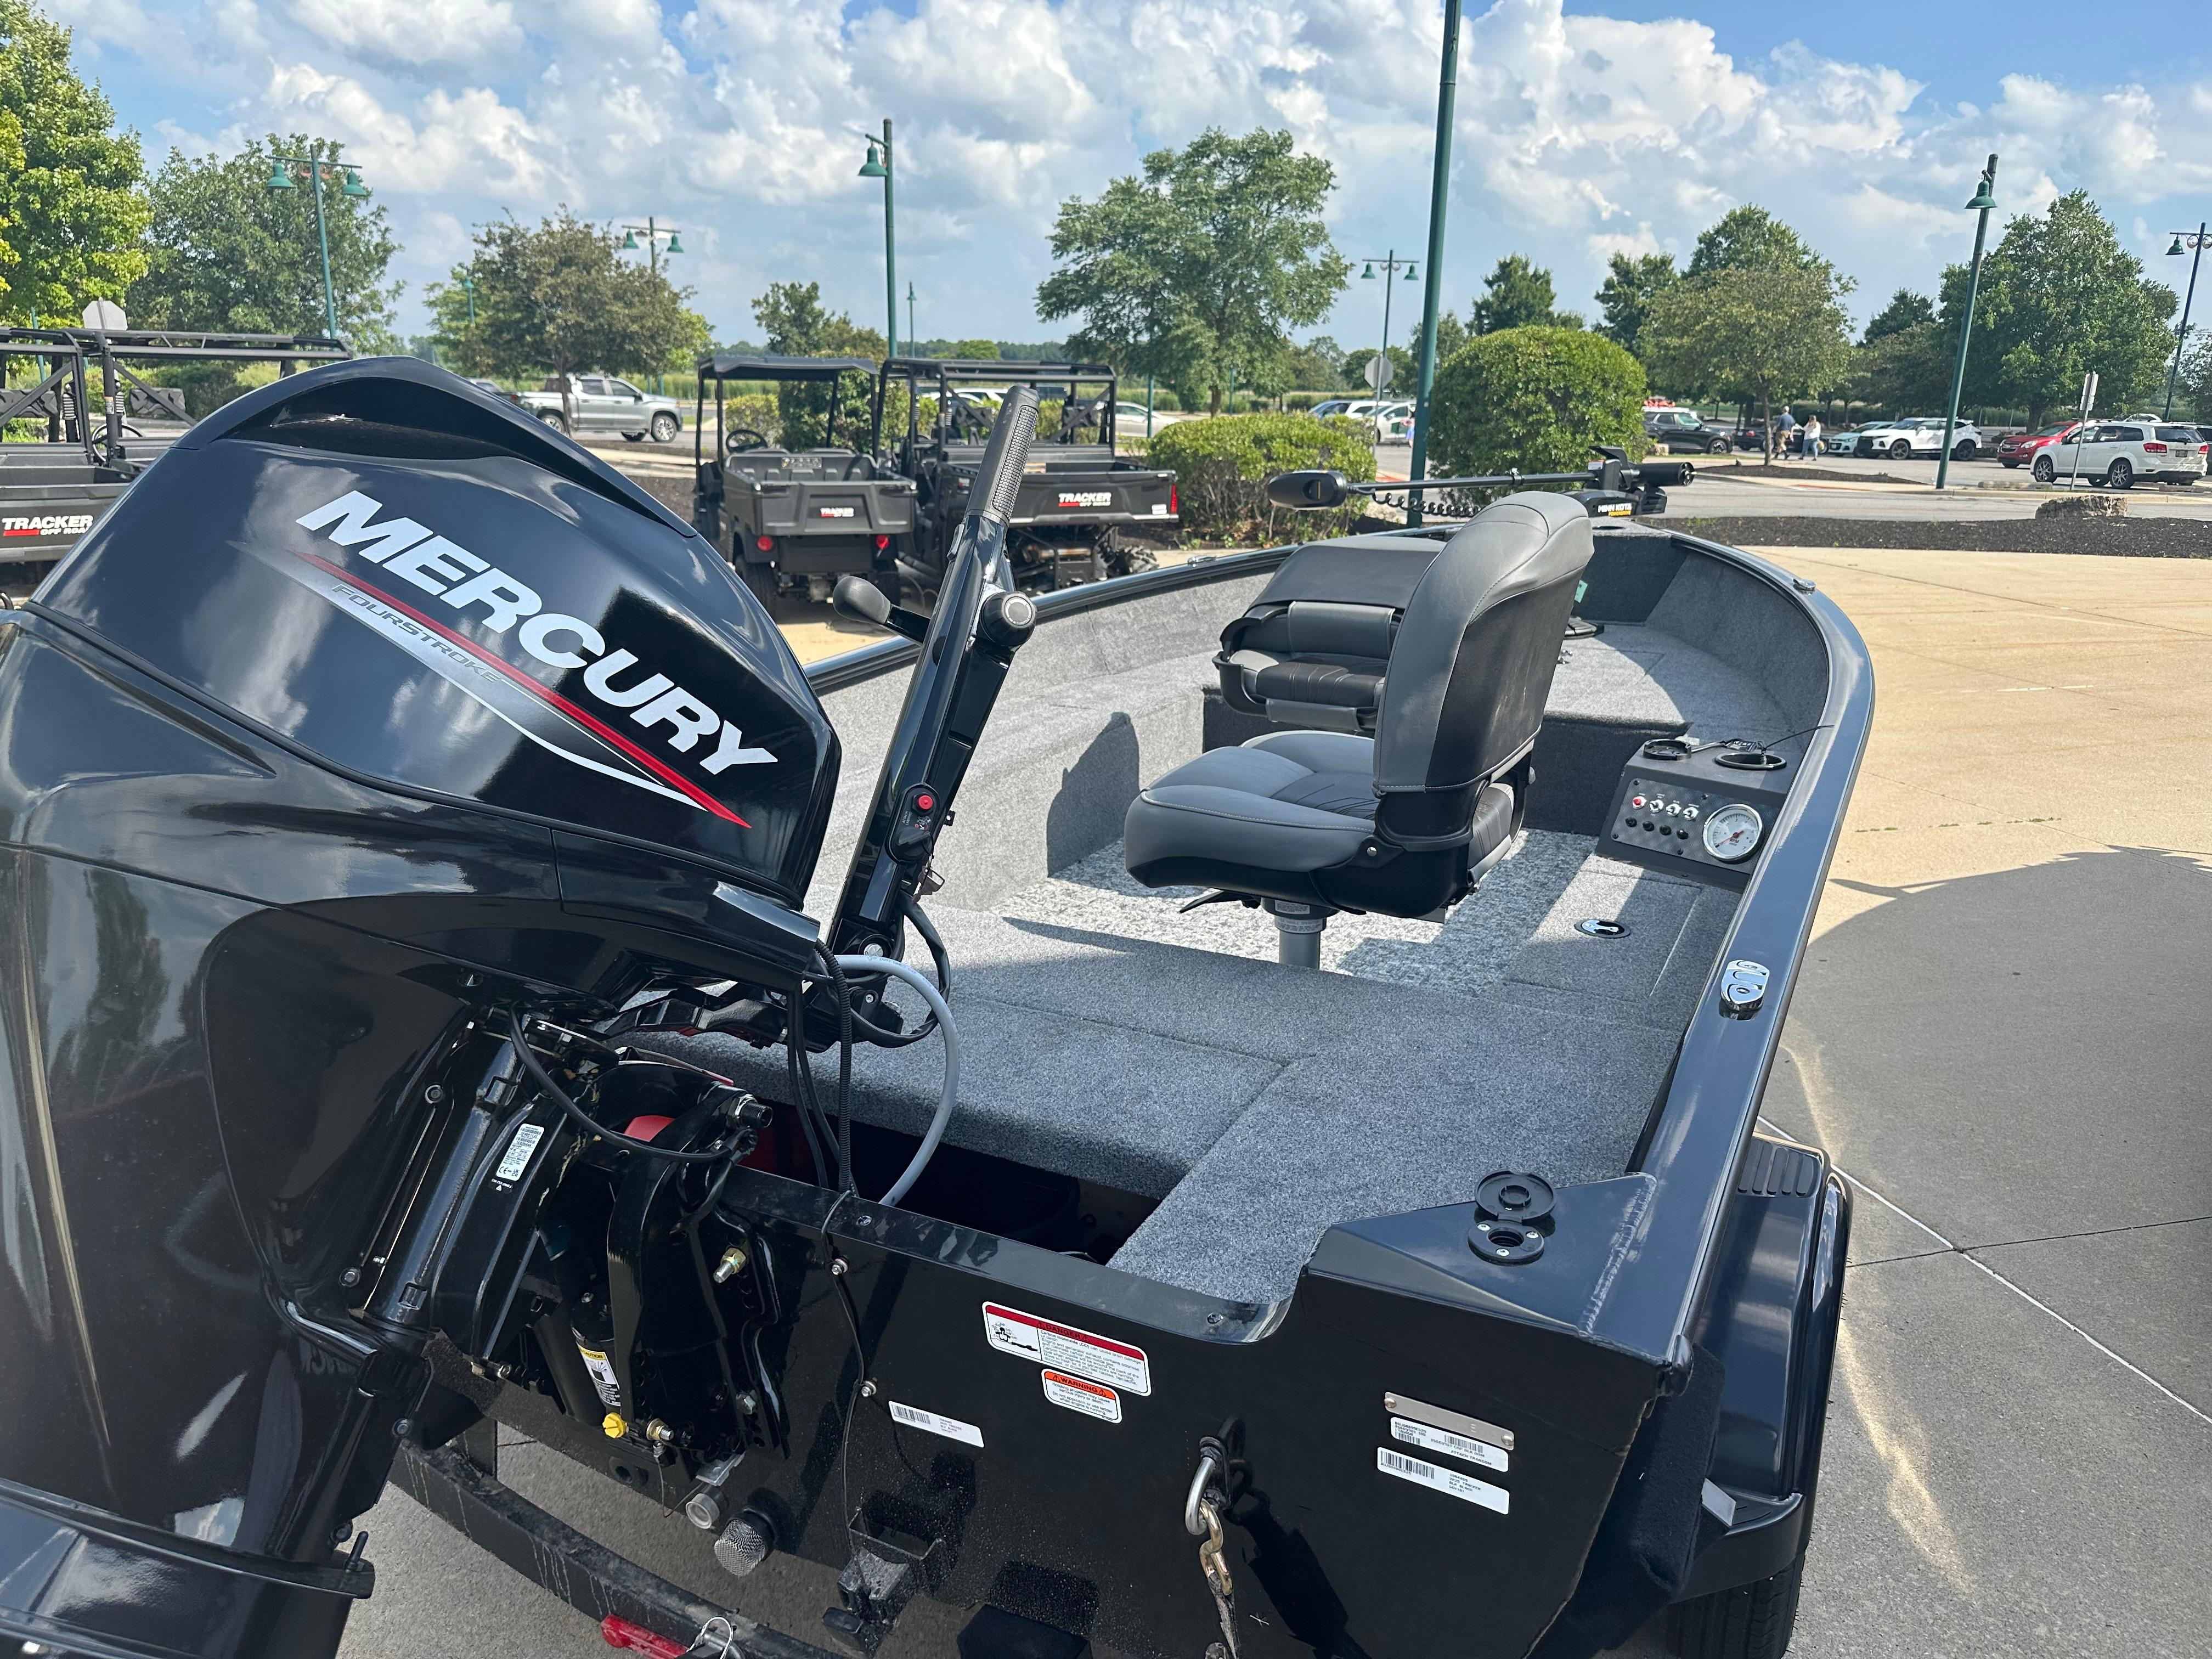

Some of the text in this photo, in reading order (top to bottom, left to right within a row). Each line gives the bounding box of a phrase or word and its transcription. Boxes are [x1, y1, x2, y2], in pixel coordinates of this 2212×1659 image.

[1058, 492, 1111, 503] TRACKER
[1598, 503, 1632, 513] MINN KOTA
[2, 515, 93, 530] TRACKER
[295, 489, 778, 775] MERCURY
[331, 583, 503, 683] FOURSTROKE
[1045, 1324, 1081, 1340] DANGER
[1060, 1376, 1098, 1393] WARNING
[1469, 1455, 1492, 1466] TRANSOM
